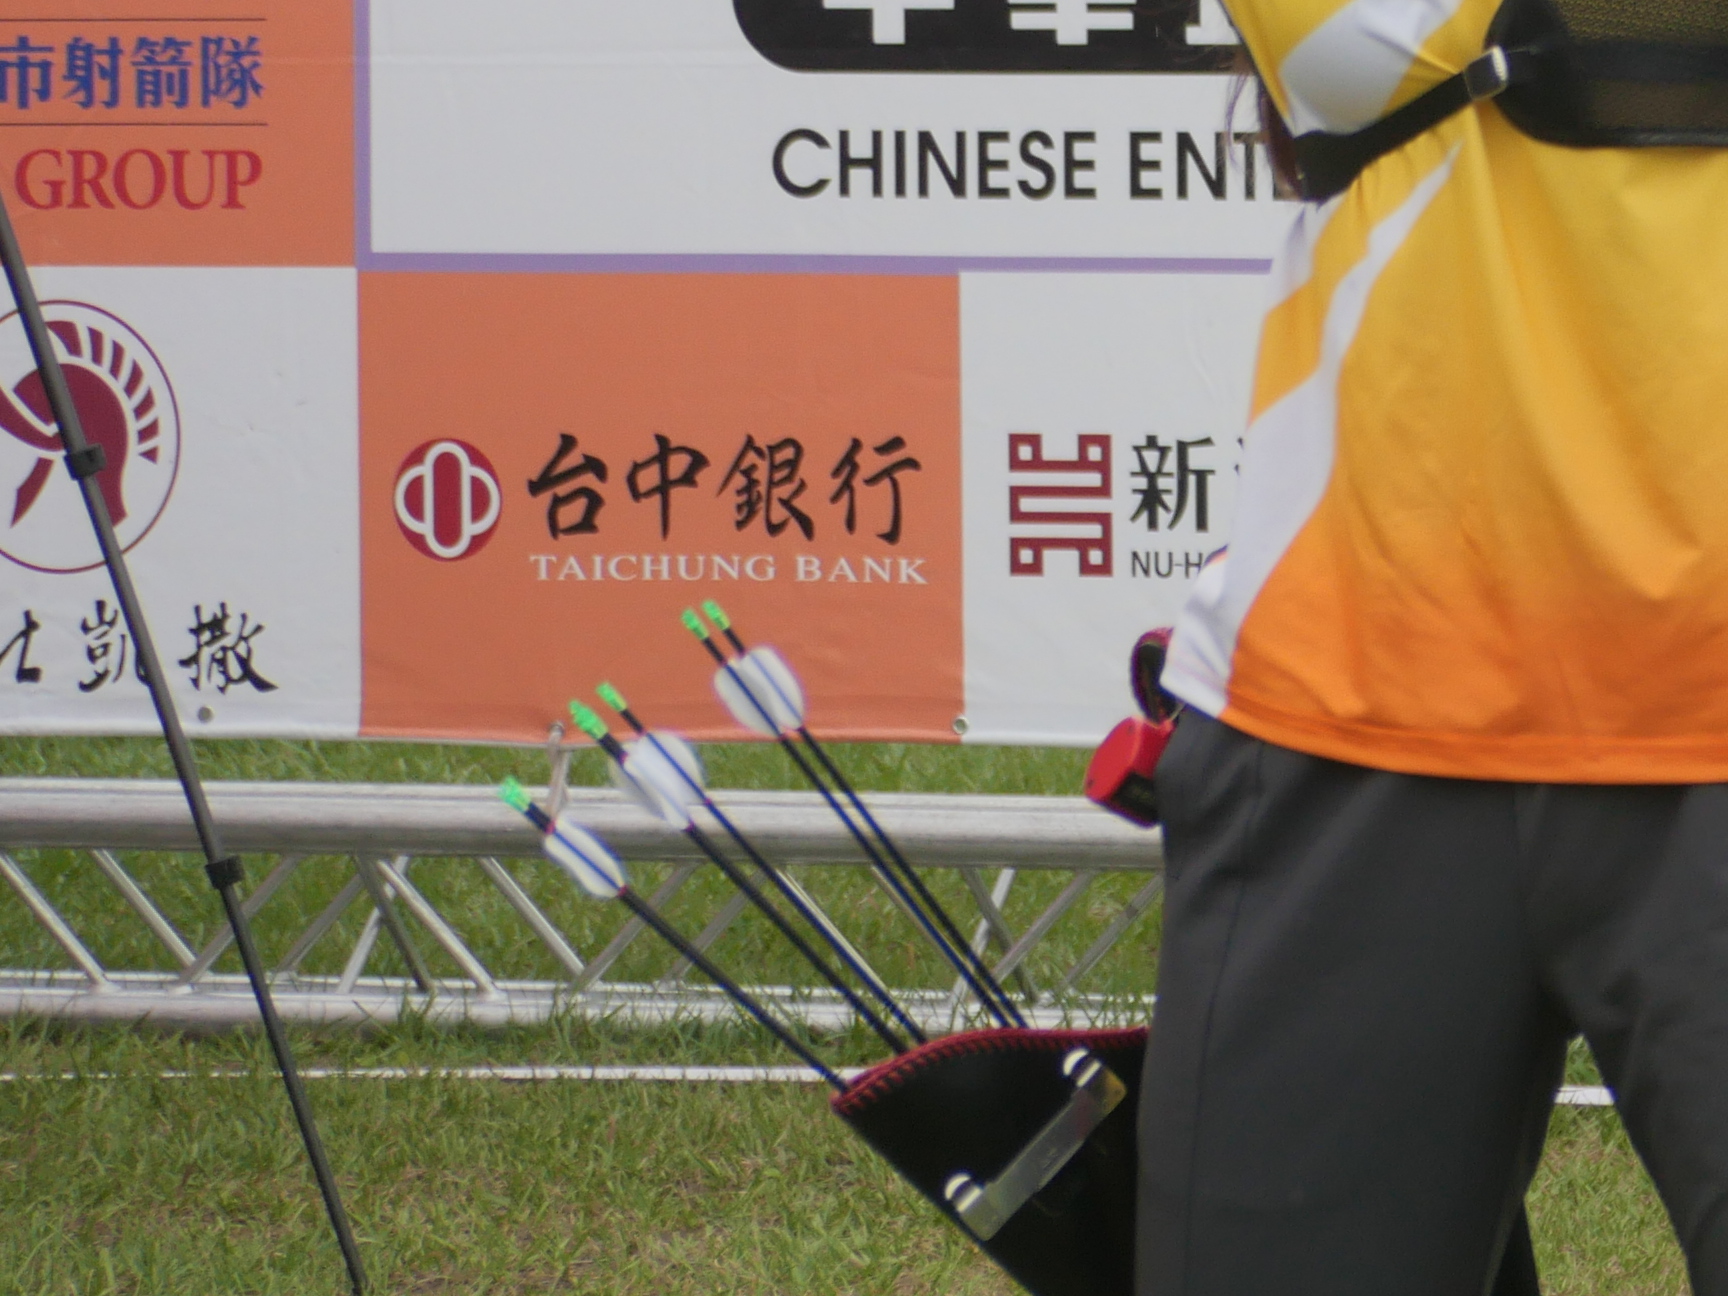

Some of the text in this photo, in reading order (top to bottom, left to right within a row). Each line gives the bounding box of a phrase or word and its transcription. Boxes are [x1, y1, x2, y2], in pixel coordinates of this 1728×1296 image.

[0, 36, 267, 109] 市射箭隊
[14, 149, 263, 210] GROUP
[772, 128, 1097, 199] CHINESE
[527, 433, 922, 545] 台中銀行
[529, 554, 928, 585] TAICHUNG BANK
